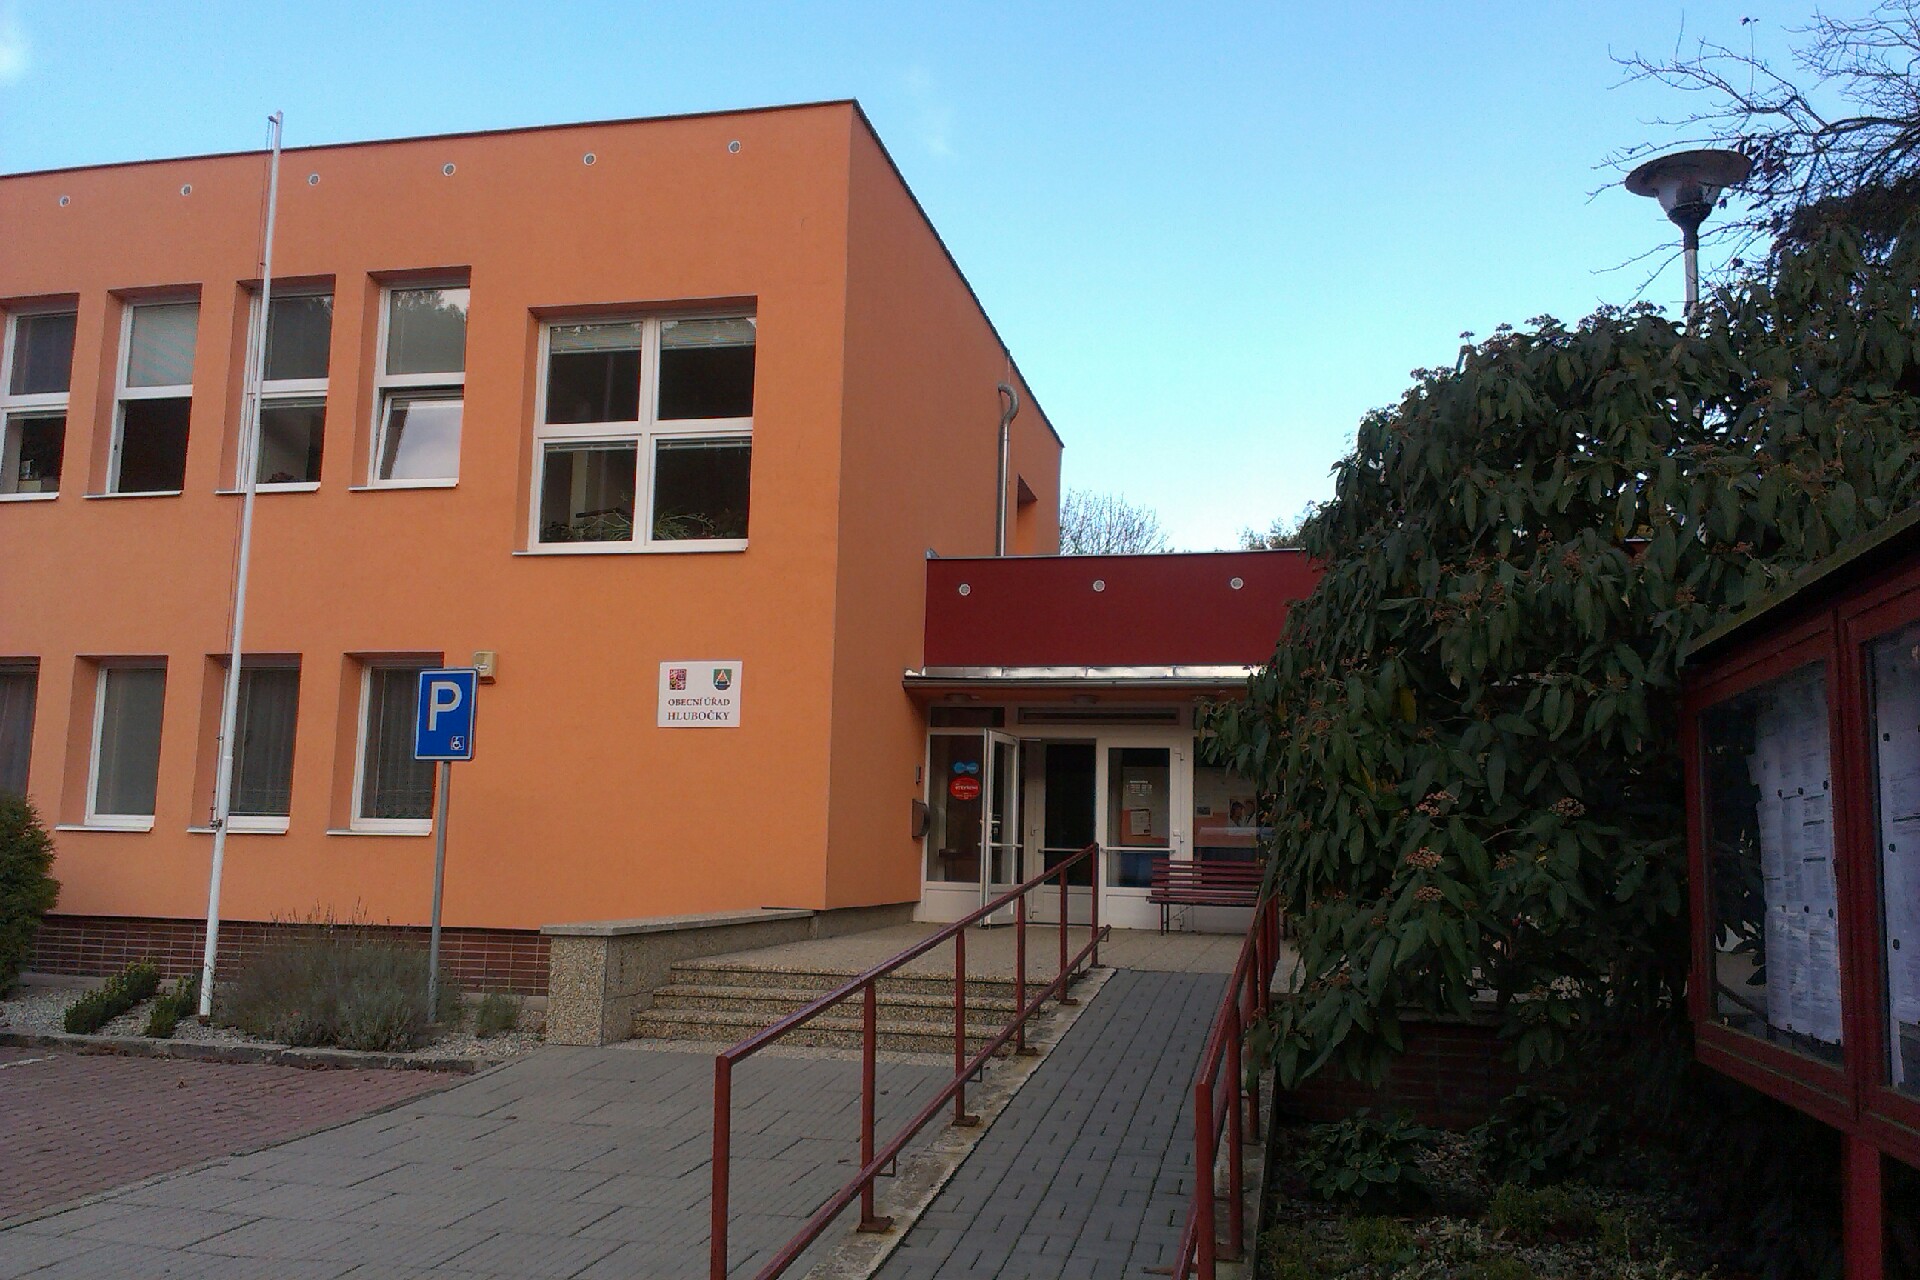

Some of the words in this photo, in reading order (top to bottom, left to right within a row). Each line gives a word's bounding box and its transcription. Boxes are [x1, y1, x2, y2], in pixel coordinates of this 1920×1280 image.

[429, 681, 462, 731] P
[668, 697, 703, 706] OBECNÍ
[704, 697, 730, 706] ÚŘAD
[668, 710, 730, 720] HLUBOČKY
